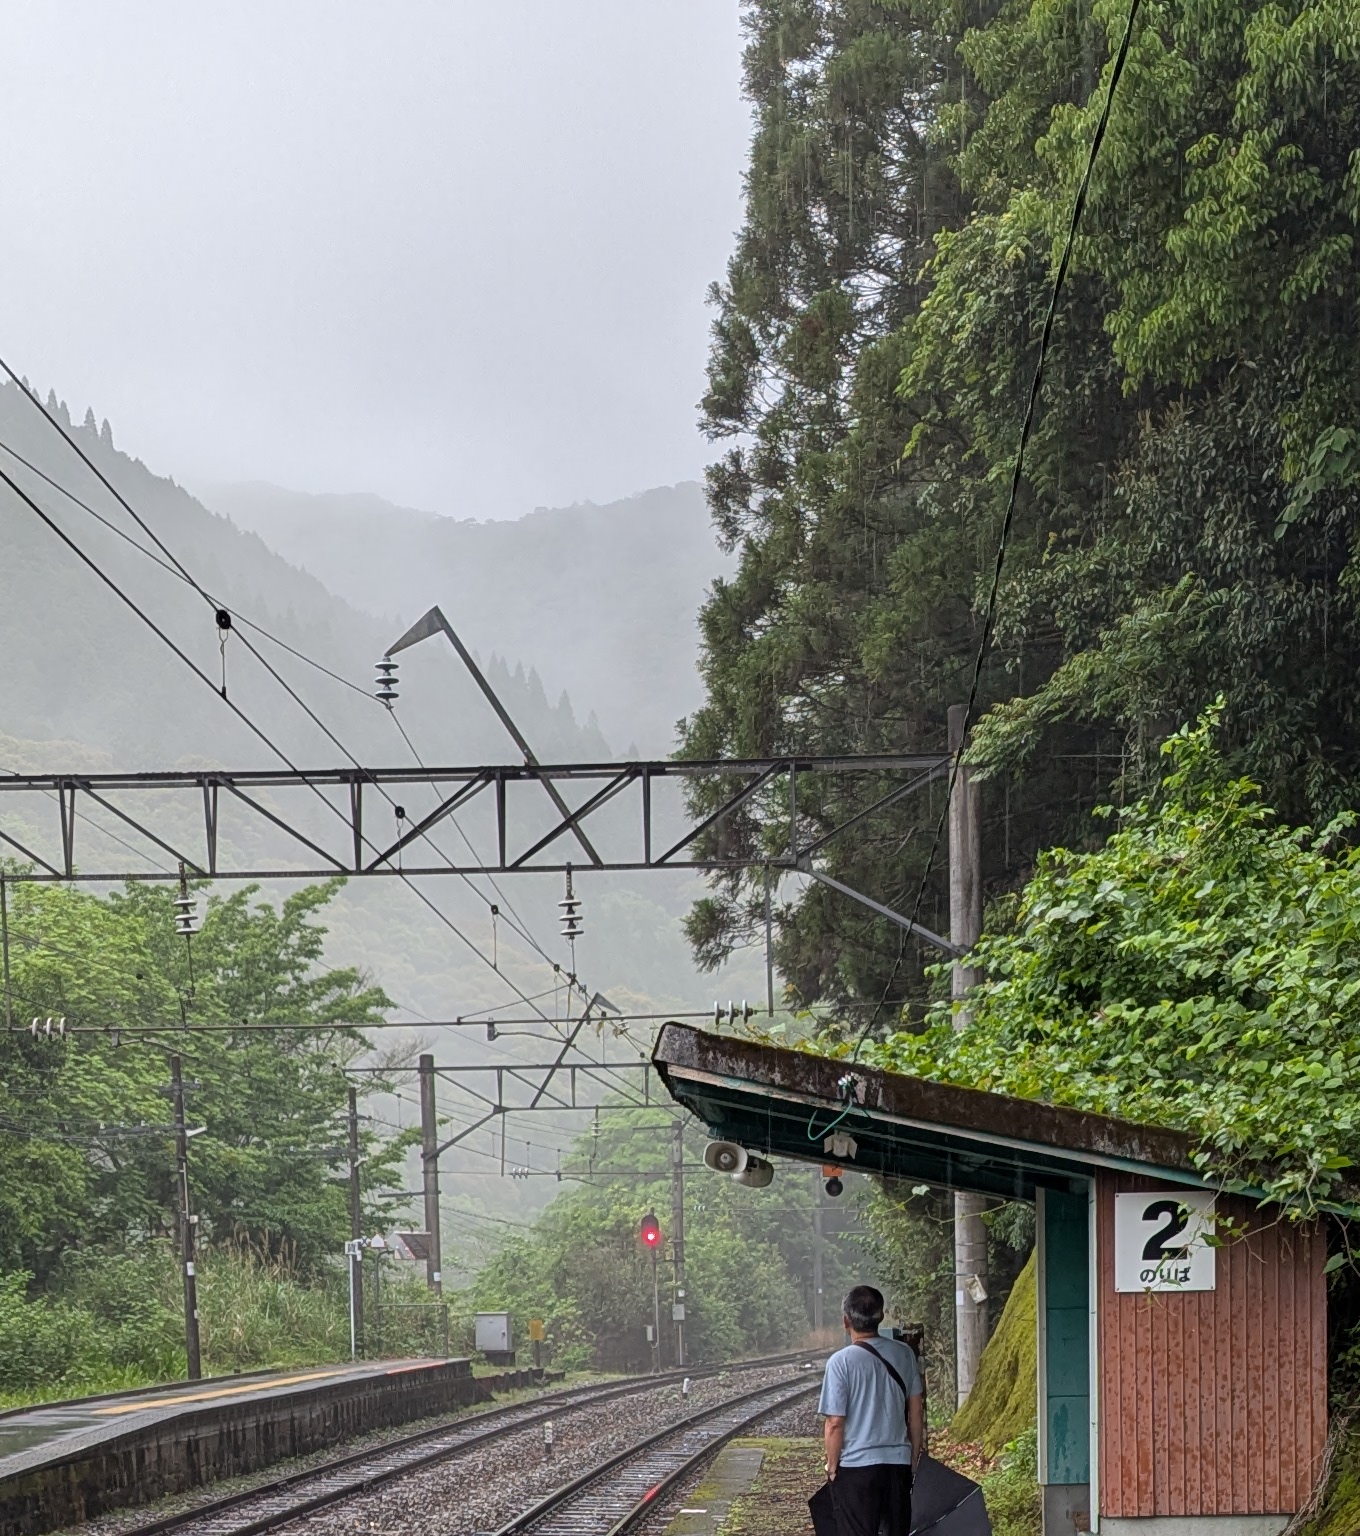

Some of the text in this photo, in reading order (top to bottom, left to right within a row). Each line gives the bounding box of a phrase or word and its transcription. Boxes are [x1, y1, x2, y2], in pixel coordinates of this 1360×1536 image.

[1141, 1199, 1190, 1262] 2
[1139, 1266, 1192, 1284] のりば
